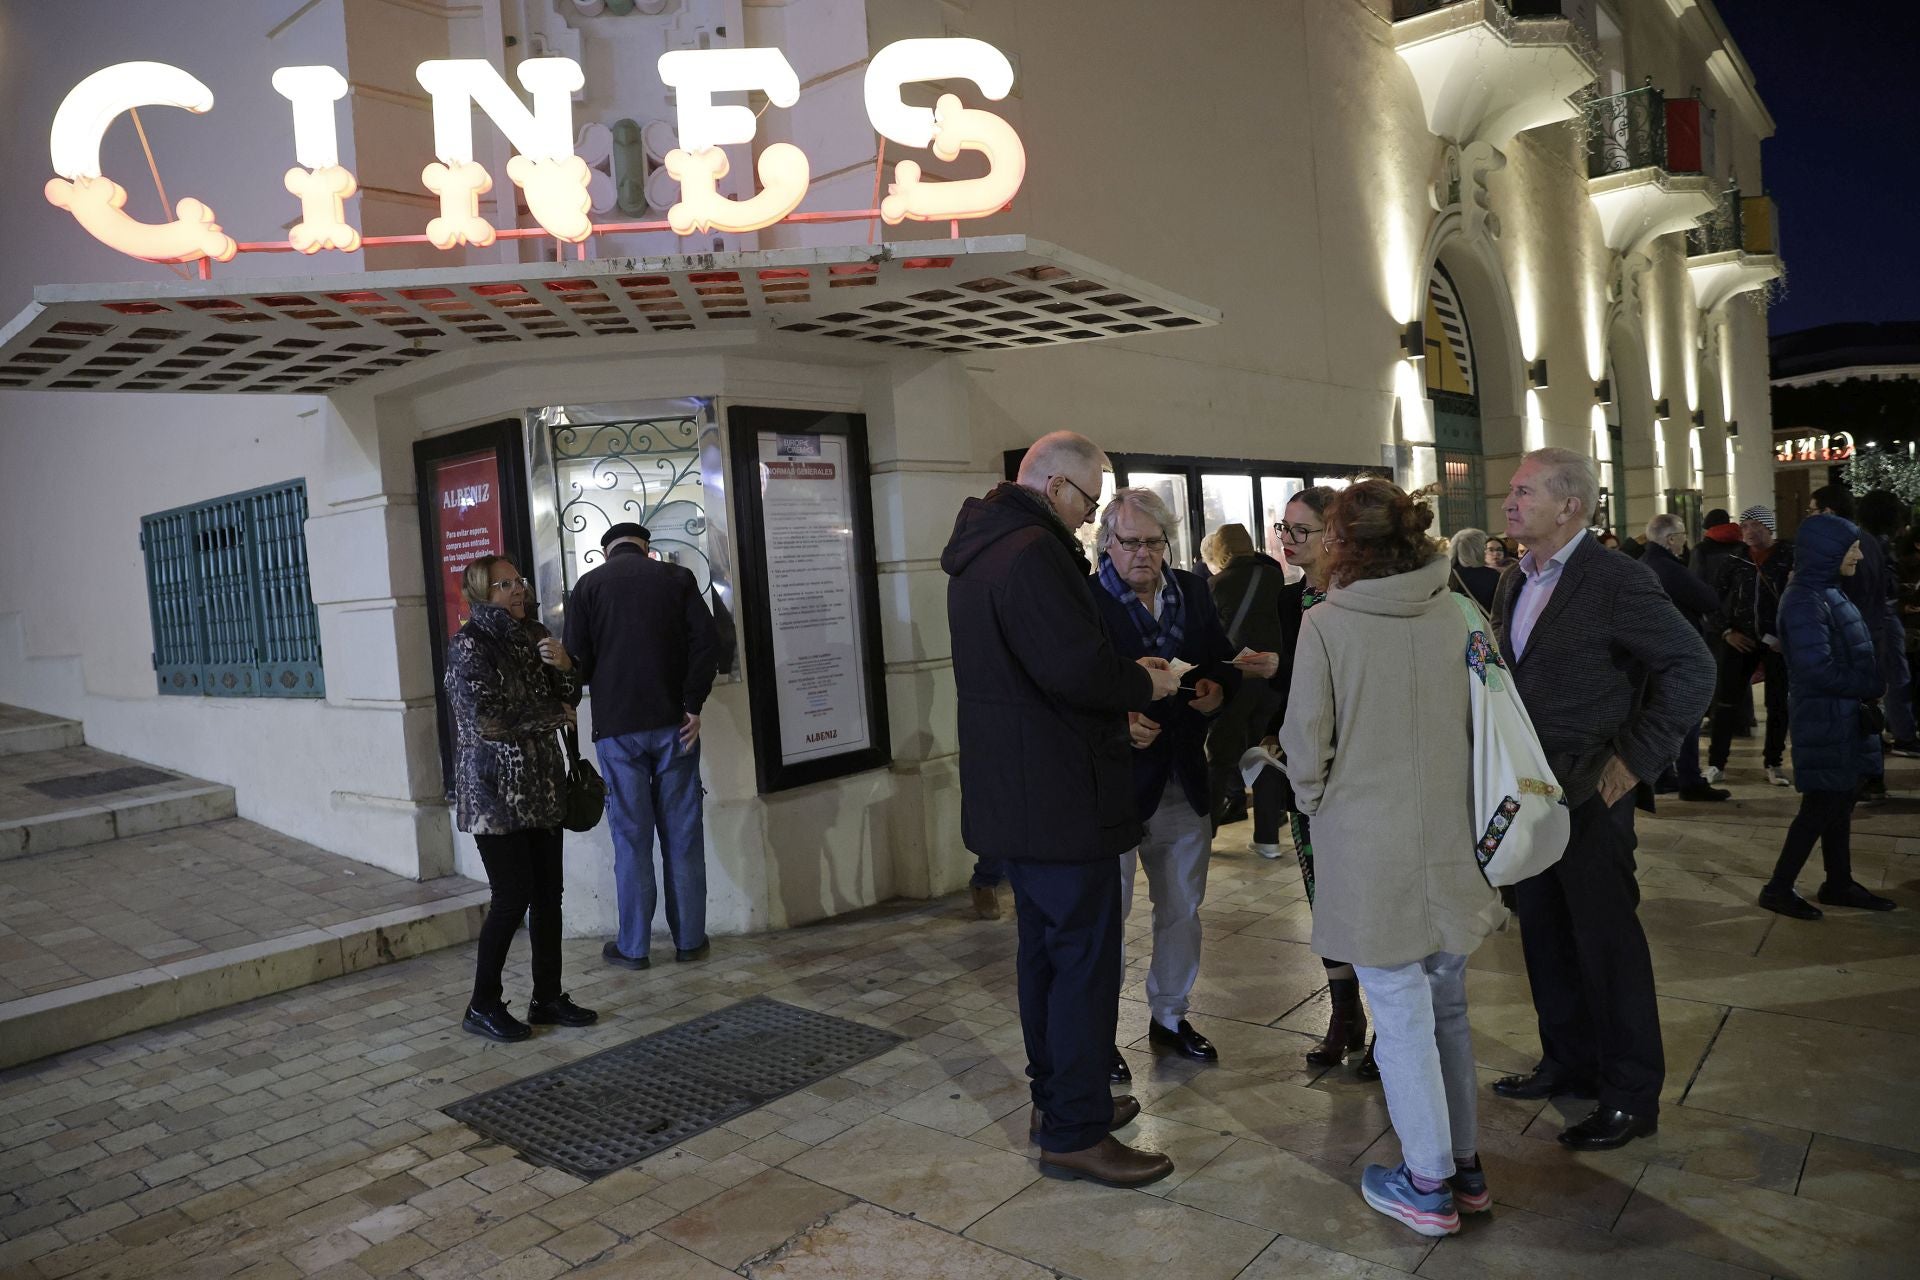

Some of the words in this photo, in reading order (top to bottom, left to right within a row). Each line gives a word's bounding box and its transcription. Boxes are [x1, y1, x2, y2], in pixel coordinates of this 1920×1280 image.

[44, 37, 1026, 265] CINES
[767, 467, 796, 475] NORMAS
[796, 468, 833, 476] GENERALES
[446, 530, 456, 538] Para
[456, 529, 469, 537] evitar
[446, 542, 461, 551] compre
[470, 537, 490, 547] entradas
[456, 551, 475, 561] taquillas
[804, 729, 838, 744] ALBENIZ
